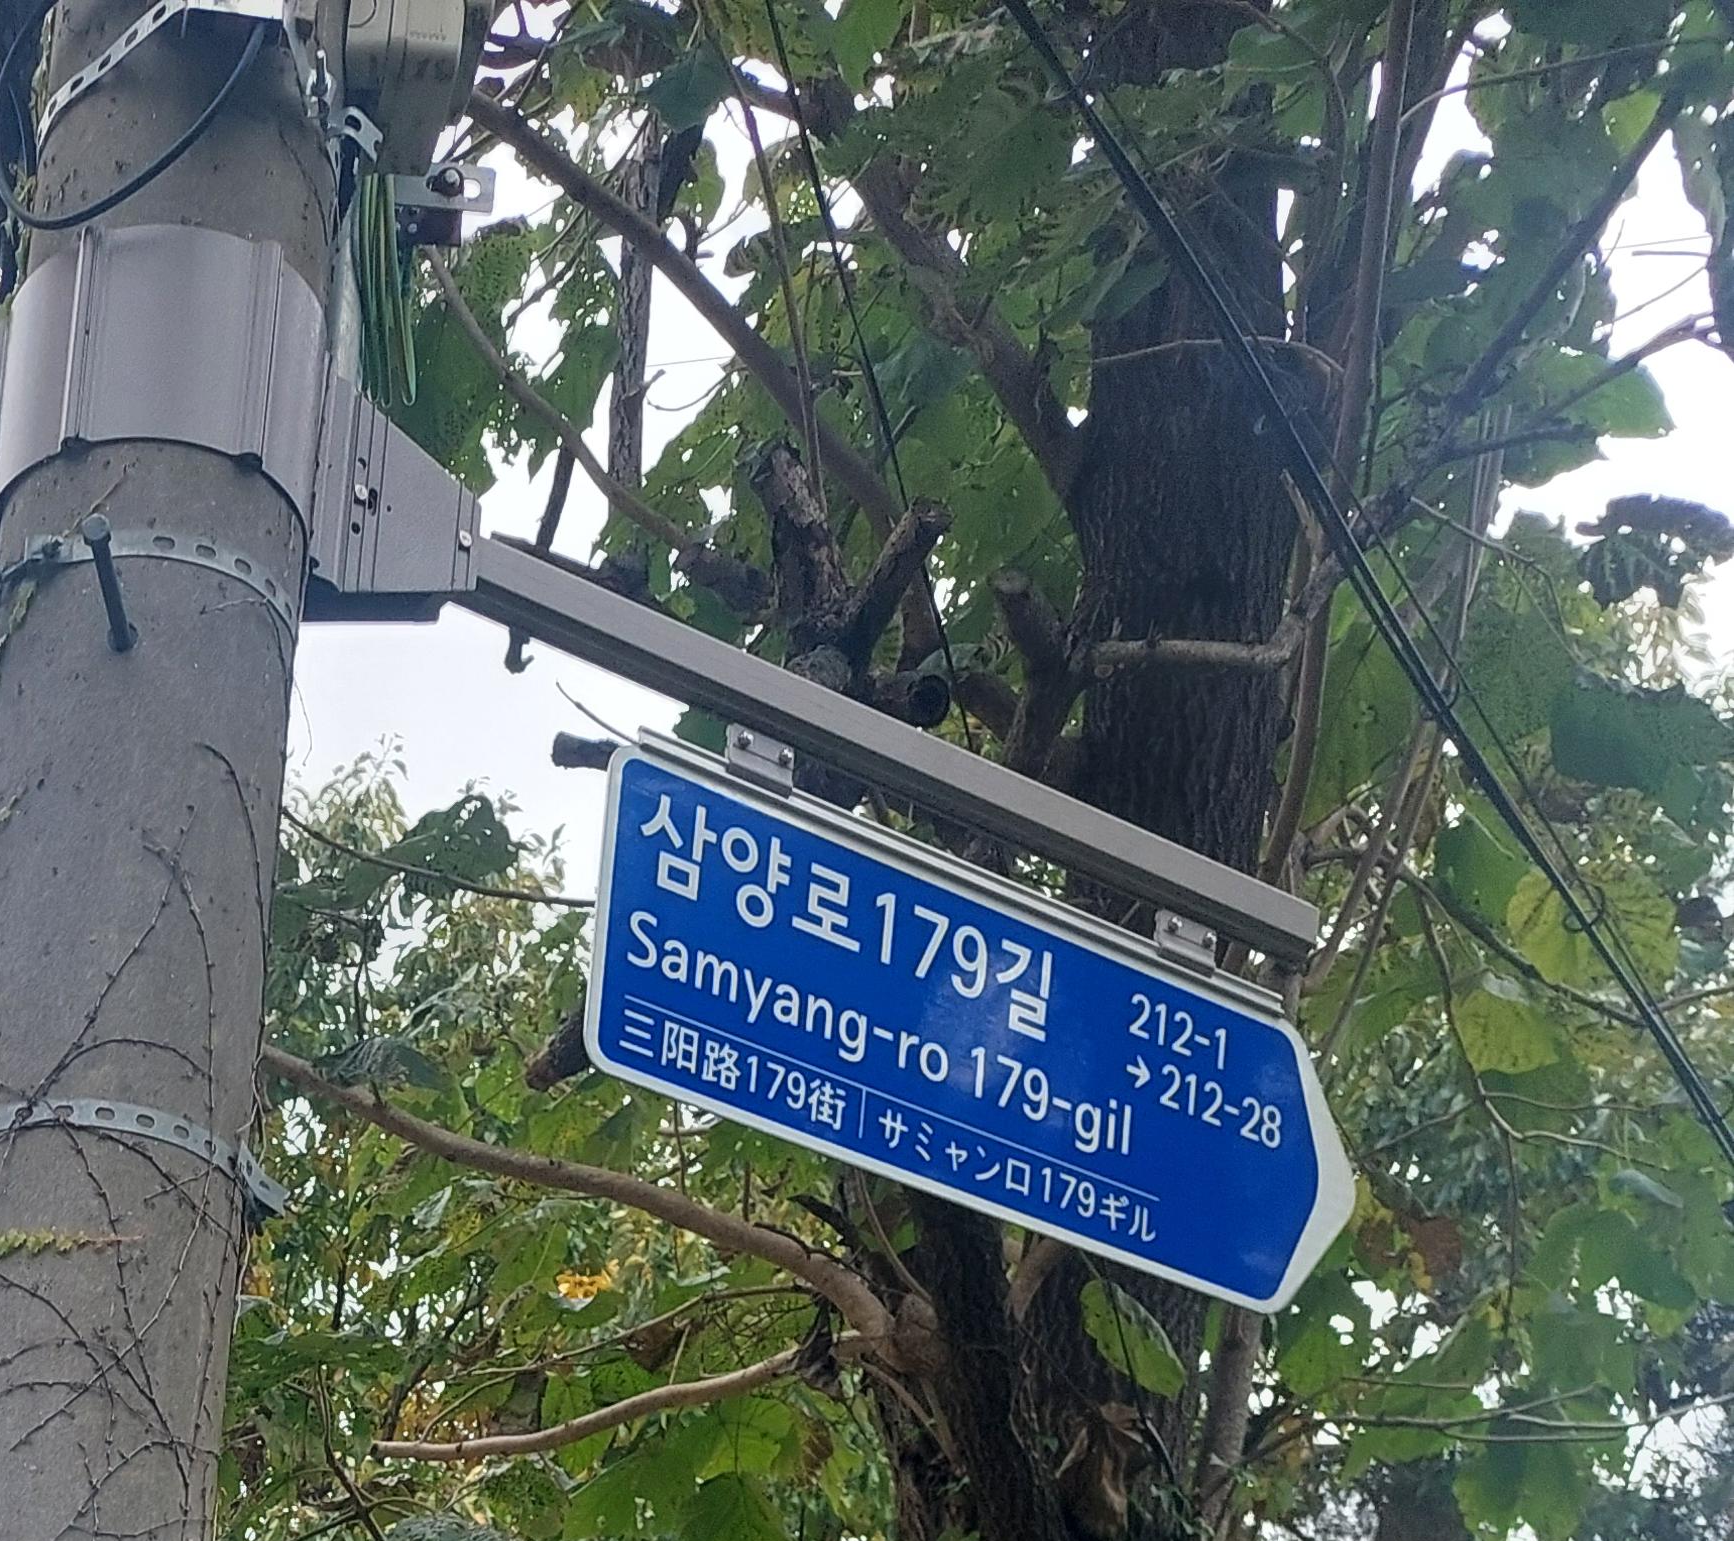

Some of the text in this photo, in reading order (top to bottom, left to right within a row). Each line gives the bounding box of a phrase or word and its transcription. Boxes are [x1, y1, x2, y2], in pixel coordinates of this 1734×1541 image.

[640, 793, 1053, 1042] 삼양로179길
[619, 1008, 847, 1131] 三阳路179街
[627, 910, 1132, 1155] Samyang-ro 179-gil
[1129, 993, 1227, 1070] 212-1
[1160, 1064, 1281, 1149] 212-28
[878, 1108, 1157, 1243] サミャンロ179ギル
